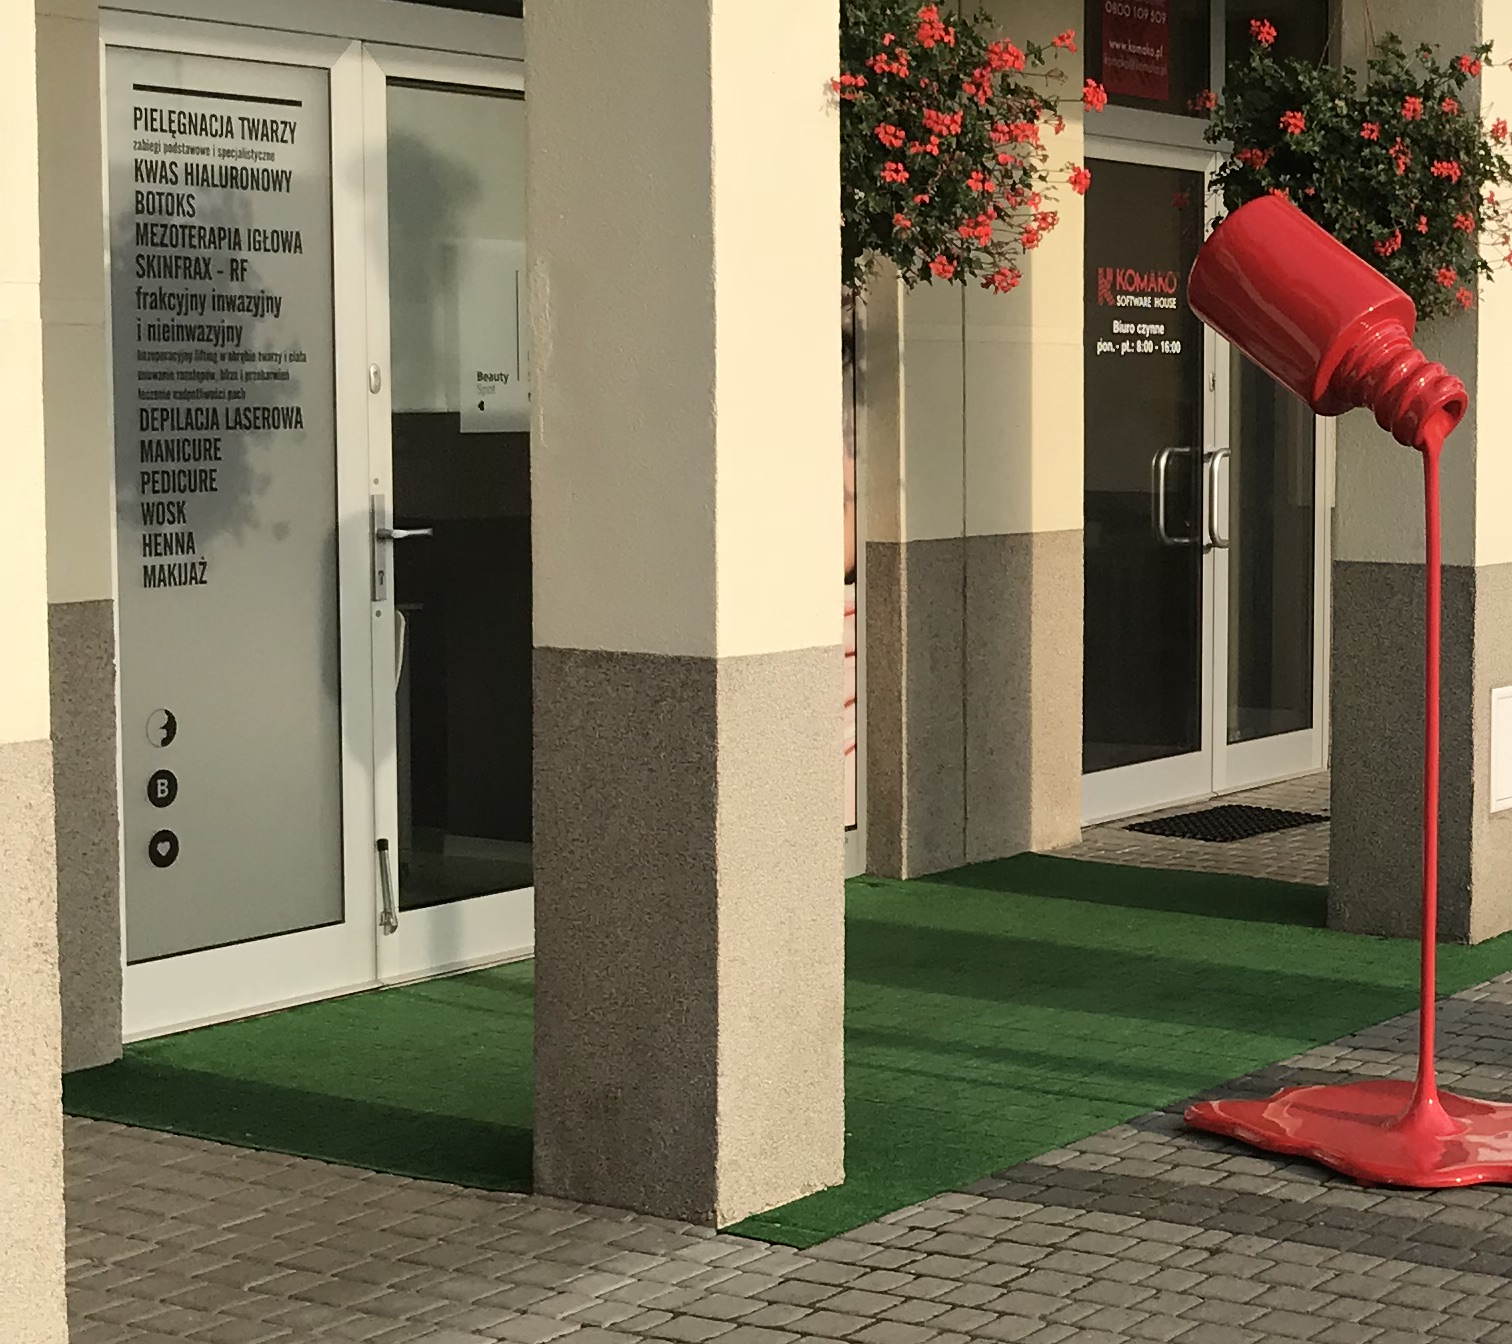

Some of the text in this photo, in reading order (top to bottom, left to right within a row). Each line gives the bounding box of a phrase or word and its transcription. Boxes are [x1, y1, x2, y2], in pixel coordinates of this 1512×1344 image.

[133, 106, 297, 145] PIELĘGNACJA TWARZY
[134, 158, 292, 193] KWAS HIALURONOWY
[135, 190, 196, 218] BOTOKS
[135, 222, 303, 254] MEZOTERAPIA IGŁOWA
[136, 253, 213, 280] SKINFRAX
[230, 258, 248, 282] RF
[135, 286, 282, 318] frakcyjny inwazyjny
[1116, 294, 1177, 309] SOFTWARE HOUSE
[136, 317, 243, 347] i nieinwazyjny
[1112, 319, 1165, 338] Biuro czynne
[1136, 340, 1153, 353] 8:00
[1160, 340, 1182, 353] 16:00
[476, 371, 509, 385] Beauty
[139, 406, 304, 432] DEPILACJA LASEROWA
[140, 437, 222, 463] MANICURE
[140, 468, 218, 494] PEDICURE
[141, 500, 187, 526] WOSK
[142, 531, 196, 557] HENNA
[143, 556, 207, 588] MAKIJAŻ
